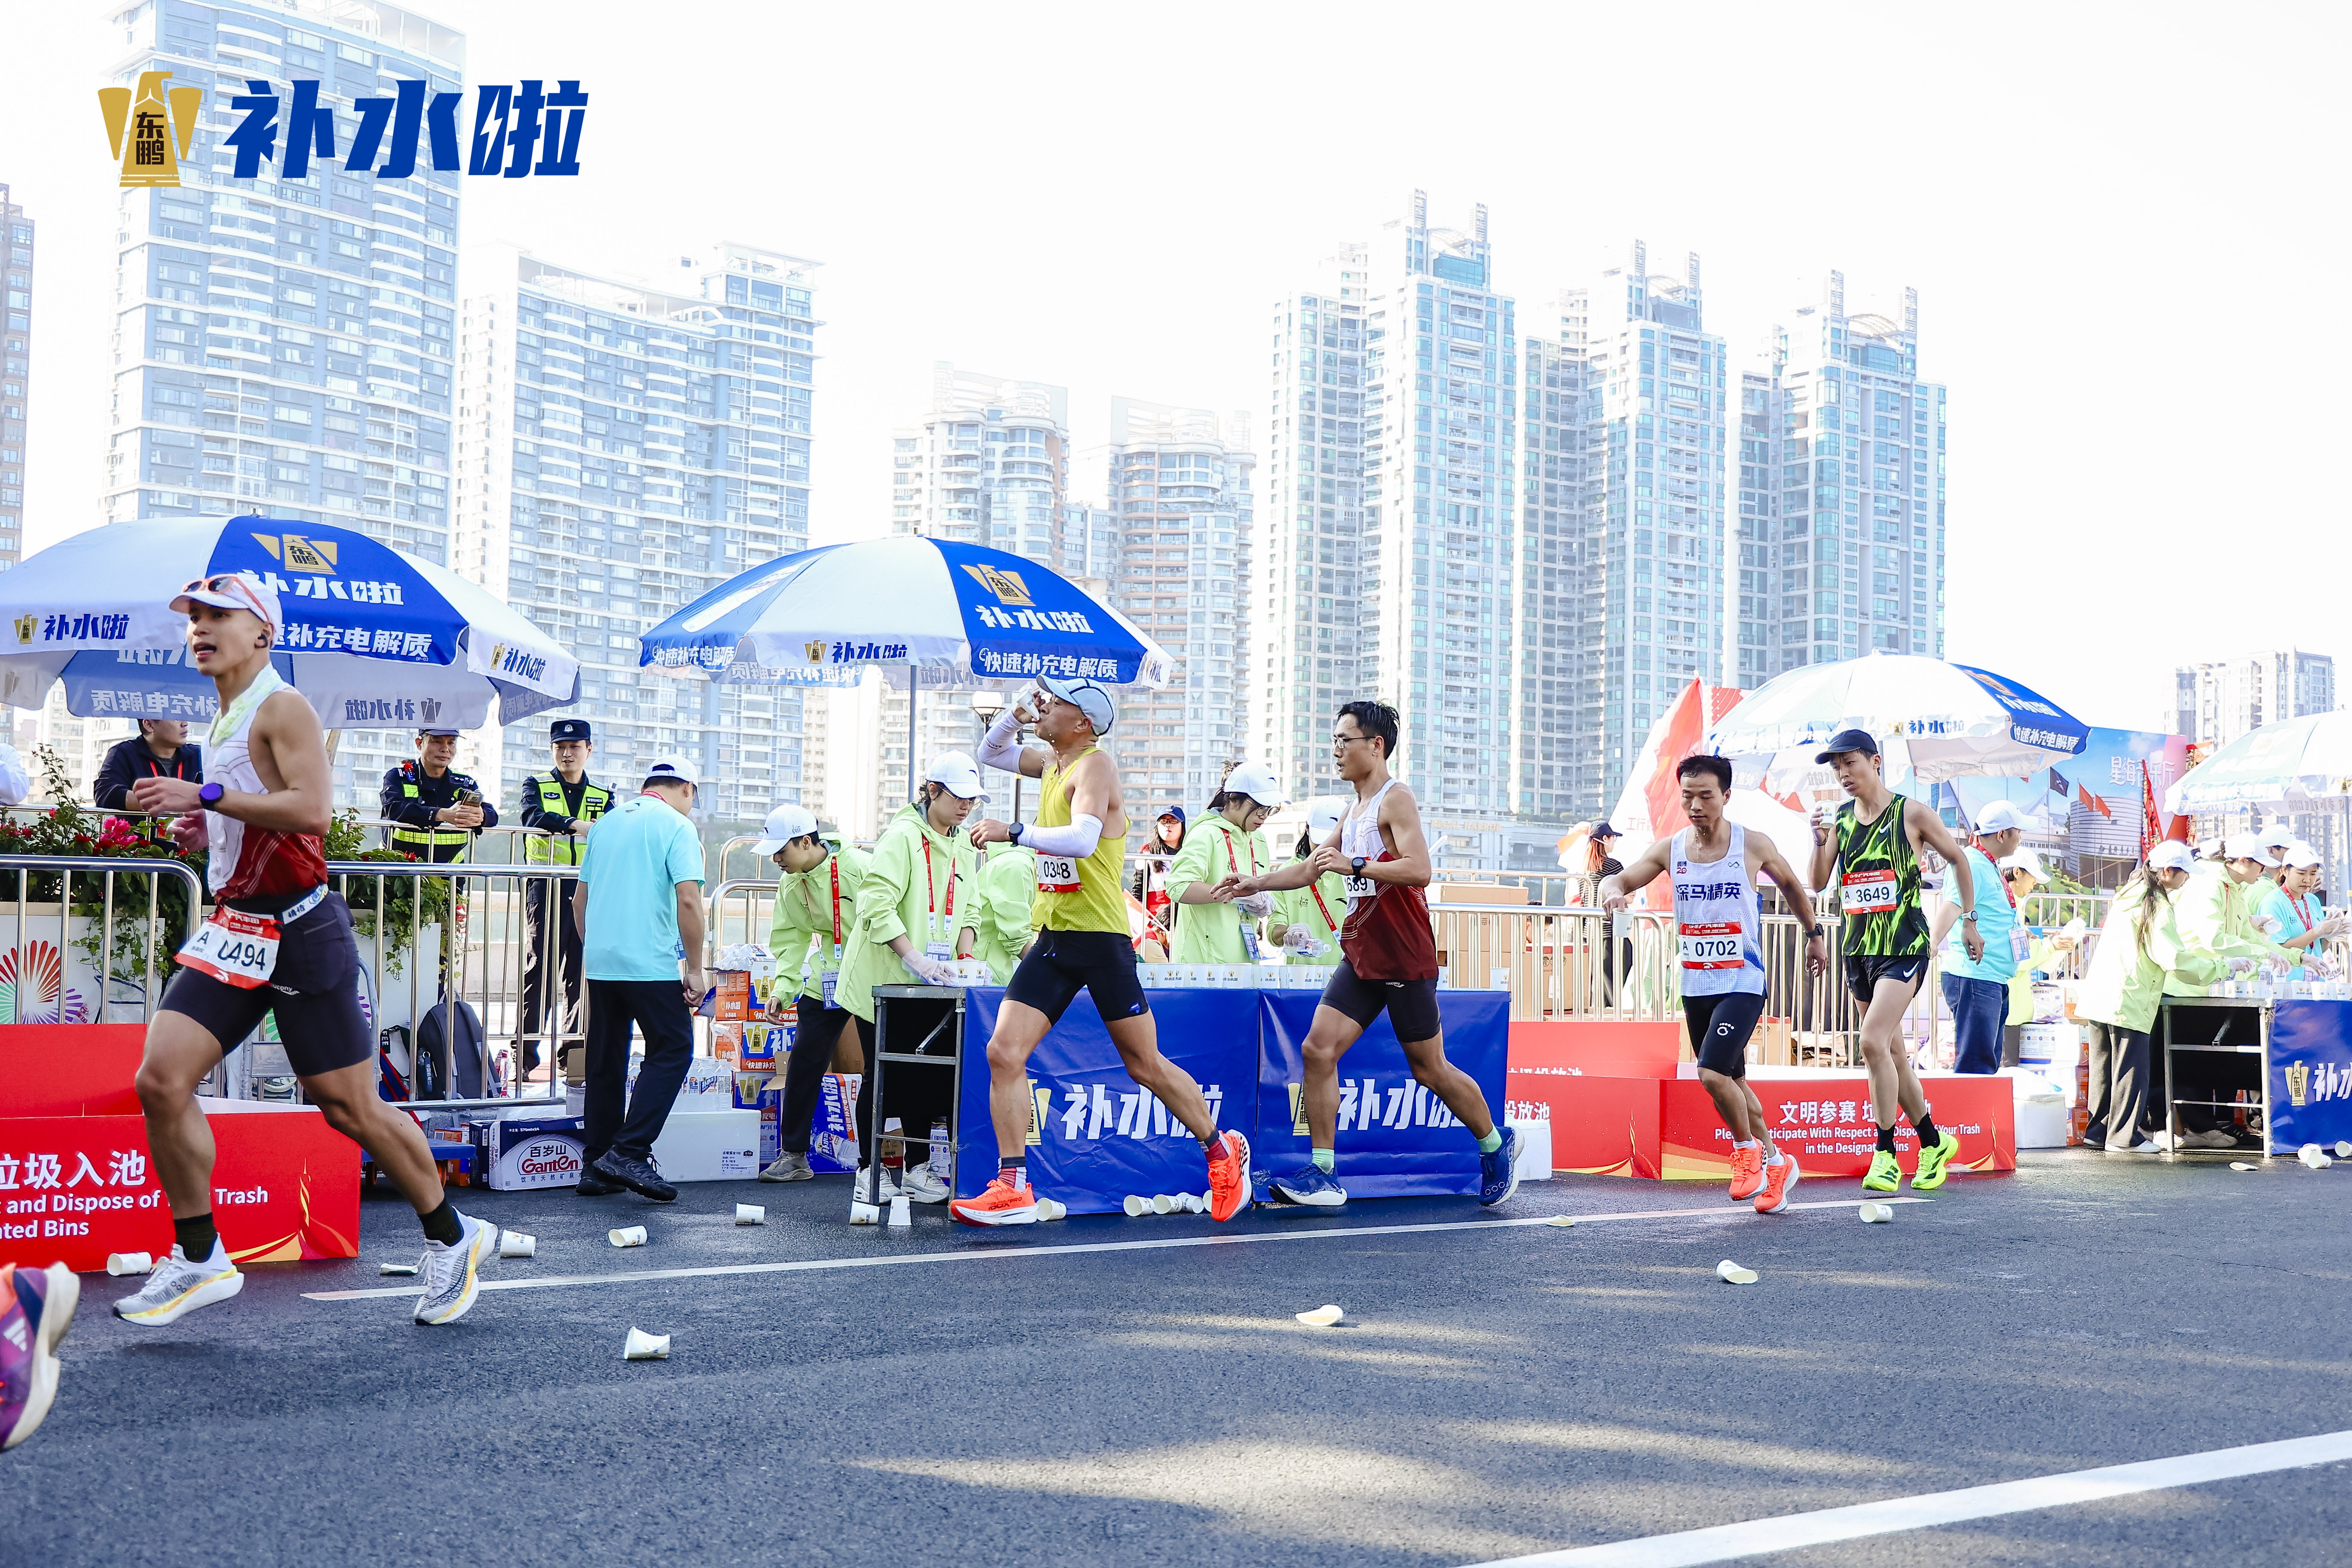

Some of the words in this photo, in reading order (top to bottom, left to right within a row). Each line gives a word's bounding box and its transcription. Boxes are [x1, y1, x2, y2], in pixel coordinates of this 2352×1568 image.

[286, 545, 319, 566] 东鹏
[989, 577, 1020, 597] 东鹏
[43, 613, 130, 641] 补水啦
[975, 605, 1095, 634] 补水啦
[831, 641, 908, 663] 补水啦
[503, 648, 546, 682] 补水啦
[984, 651, 1118, 678] 快速补充电解质
[1908, 720, 1965, 734] 补水啦
[1044, 861, 1071, 879] 0348
[1675, 882, 1741, 901] 深马精英
[1845, 891, 1850, 899] A
[1856, 886, 1890, 903] 3649
[197, 931, 210, 945] A
[1683, 941, 1688, 951] A
[1695, 940, 1736, 957] 0702
[762, 984, 768, 998] 东鹏
[725, 1001, 741, 1010] 补水啦
[753, 1034, 760, 1047] 东鹏
[771, 1029, 796, 1056] 补
[821, 1076, 845, 1132] 补水啦
[1779, 1100, 1856, 1125] 文明参赛
[1809, 1126, 1833, 1139] With
[1834, 1126, 1871, 1139] Respect
[1938, 1124, 1958, 1135] Your
[1959, 1123, 1981, 1135] Trash
[530, 1144, 567, 1158] 百岁山
[1805, 1142, 1816, 1154] in
[1817, 1142, 1834, 1154] the
[6, 1194, 47, 1214] and
[52, 1192, 134, 1215] Dispose
[139, 1190, 162, 1208] of
[215, 1186, 269, 1205] Trash
[44, 1218, 89, 1238] Bins
